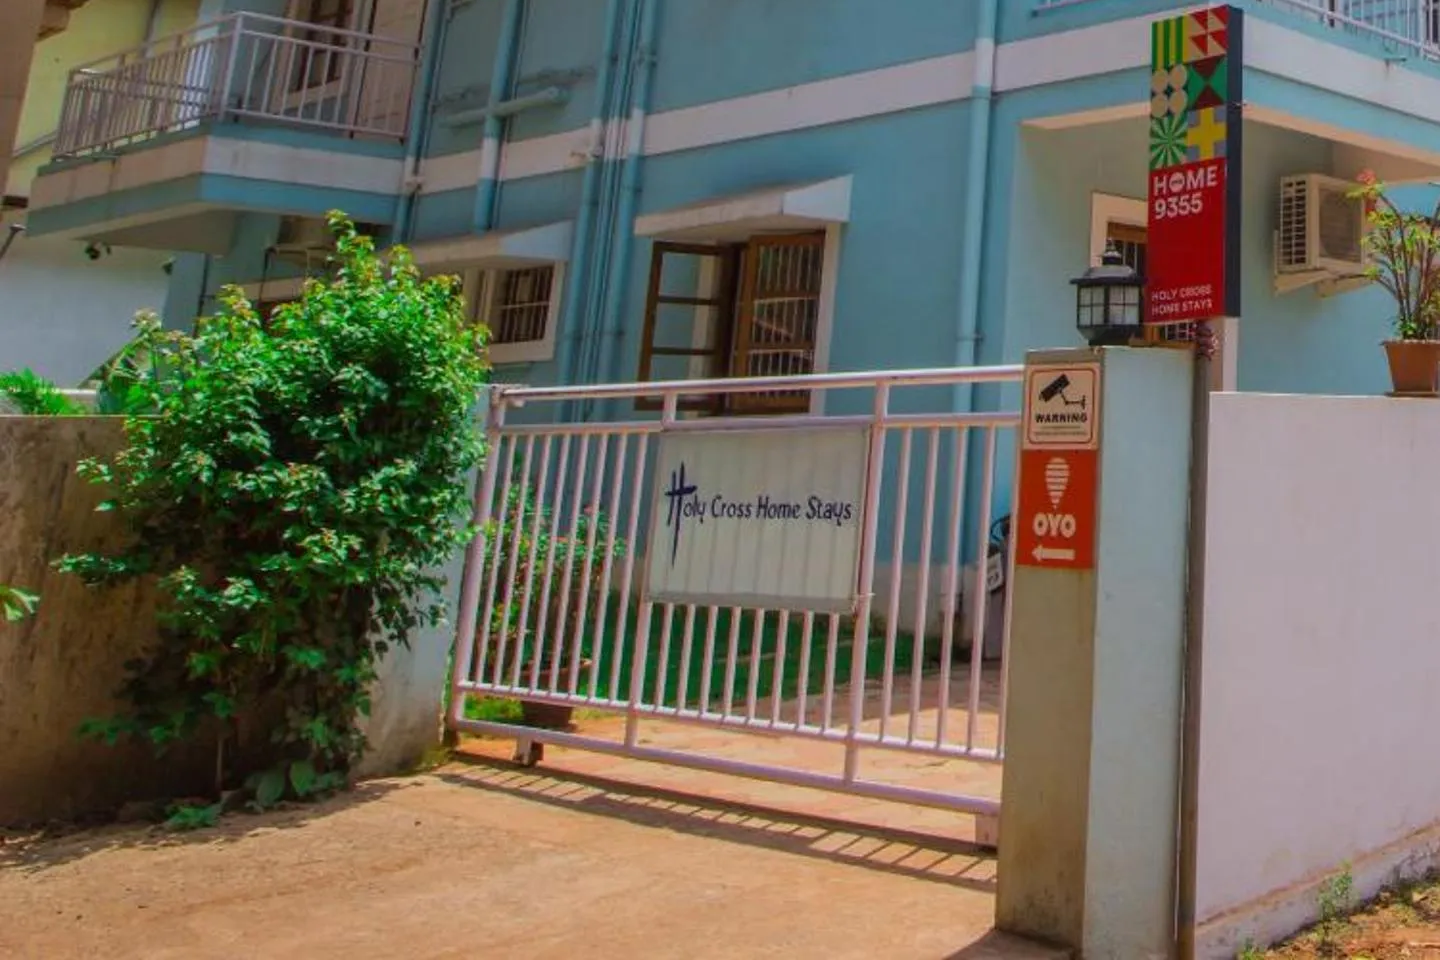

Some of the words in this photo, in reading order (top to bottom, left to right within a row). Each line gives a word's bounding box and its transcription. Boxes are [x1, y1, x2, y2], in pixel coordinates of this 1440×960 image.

[1154, 166, 1218, 196] HOME
[1155, 192, 1203, 220] 9355
[1152, 288, 1178, 301] HOLY
[1035, 413, 1088, 424] WARNING
[665, 461, 705, 568] Holy
[711, 495, 752, 519] Cross
[756, 496, 801, 520] Home
[806, 496, 852, 527] Stays
[1033, 513, 1077, 538] OYO
